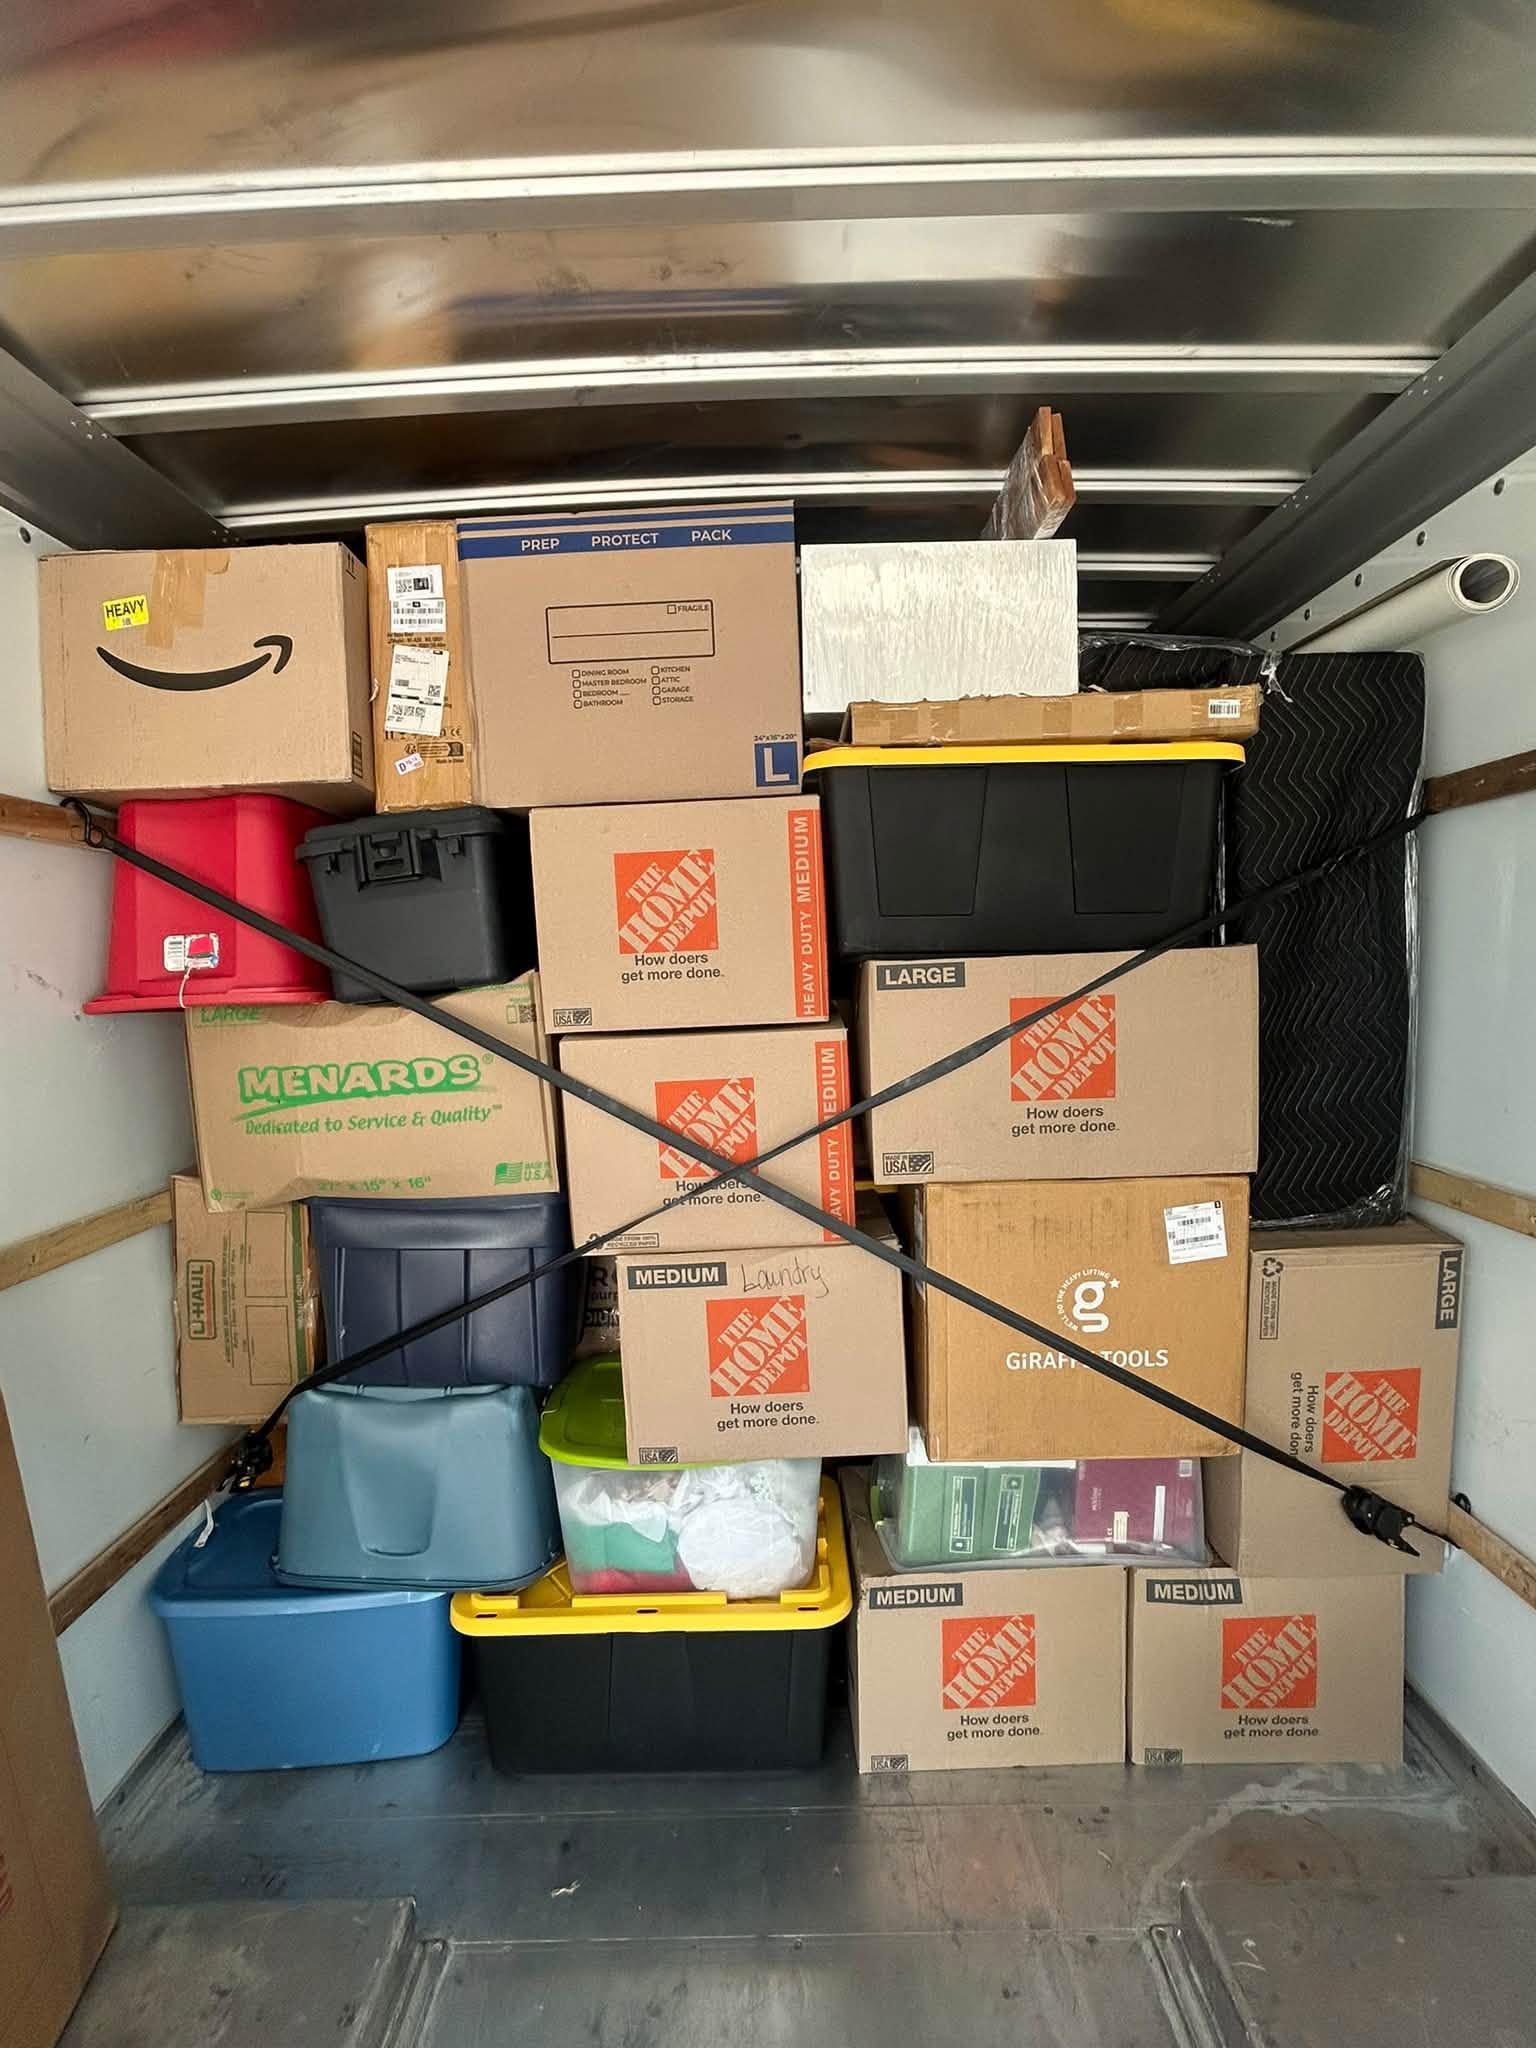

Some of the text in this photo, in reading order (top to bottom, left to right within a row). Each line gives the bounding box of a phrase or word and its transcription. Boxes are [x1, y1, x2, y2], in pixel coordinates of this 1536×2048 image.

[521, 529, 732, 551] PREP PROTECT PACK
[105, 599, 144, 618] HEAVY
[678, 604, 709, 612] FRAGILE
[584, 699, 623, 707] BATHROOM
[764, 747, 790, 782] L
[625, 861, 666, 903] THE
[619, 850, 715, 954] HOME
[657, 886, 716, 952] DEPOT
[794, 816, 816, 1015] HEAVY DUTY MEDIUM
[621, 970, 644, 984] get
[647, 968, 682, 979] more
[635, 952, 708, 966] How doers
[885, 968, 956, 985] LARGE
[200, 1007, 263, 1023] LARGE
[555, 1013, 572, 1025] USA
[1020, 1012, 1064, 1051] THE
[1011, 997, 1115, 1100] HOME
[1053, 1033, 1116, 1098] DEPOT
[239, 1054, 481, 1103] MENARDS
[245, 1119, 319, 1136] Dedicated
[324, 1117, 342, 1132] to
[348, 1113, 406, 1130] Service
[412, 1112, 425, 1126] &
[666, 1089, 707, 1129] THE
[1026, 1105, 1104, 1119] How doers
[1011, 1123, 1035, 1136] get
[1039, 1121, 1076, 1133] more
[827, 1139, 841, 1180] DUTY
[885, 1160, 908, 1173] USA
[408, 1175, 431, 1189] 16"
[689, 1195, 723, 1205] more
[636, 1267, 719, 1286] MEDIUM
[741, 1256, 829, 1299] Laundry
[1440, 1257, 1458, 1321] LARGE
[192, 1264, 206, 1334] U-HAUL
[717, 1308, 758, 1349] THE
[711, 1296, 806, 1396] HOME
[749, 1330, 808, 1394] DEPOT
[1290, 1372, 1304, 1393] get
[1374, 1378, 1411, 1416] THE
[717, 1420, 739, 1432] get
[743, 1417, 777, 1428] more
[731, 1401, 804, 1415] How doers
[1291, 1396, 1301, 1429] more
[1304, 1385, 1319, 1453] How doers
[1326, 1372, 1416, 1459] HOME
[1324, 1408, 1382, 1460] DEPOT
[641, 1453, 658, 1463] USA
[876, 1588, 955, 1605] MEDIUM
[1154, 1583, 1234, 1600] MEDIUM
[943, 1615, 1035, 1709] HOME
[952, 1627, 990, 1664] THE
[1222, 1616, 1317, 1707] HOME
[1231, 1627, 1272, 1665] THE
[980, 1649, 1036, 1707] DEPOT
[1260, 1650, 1317, 1708] DEPOT
[947, 1729, 968, 1741] get
[971, 1728, 1004, 1738] more
[961, 1713, 1029, 1725] How doers
[1224, 1728, 1246, 1740] get
[1248, 1728, 1283, 1737] more
[1238, 1715, 1309, 1725] How doers
